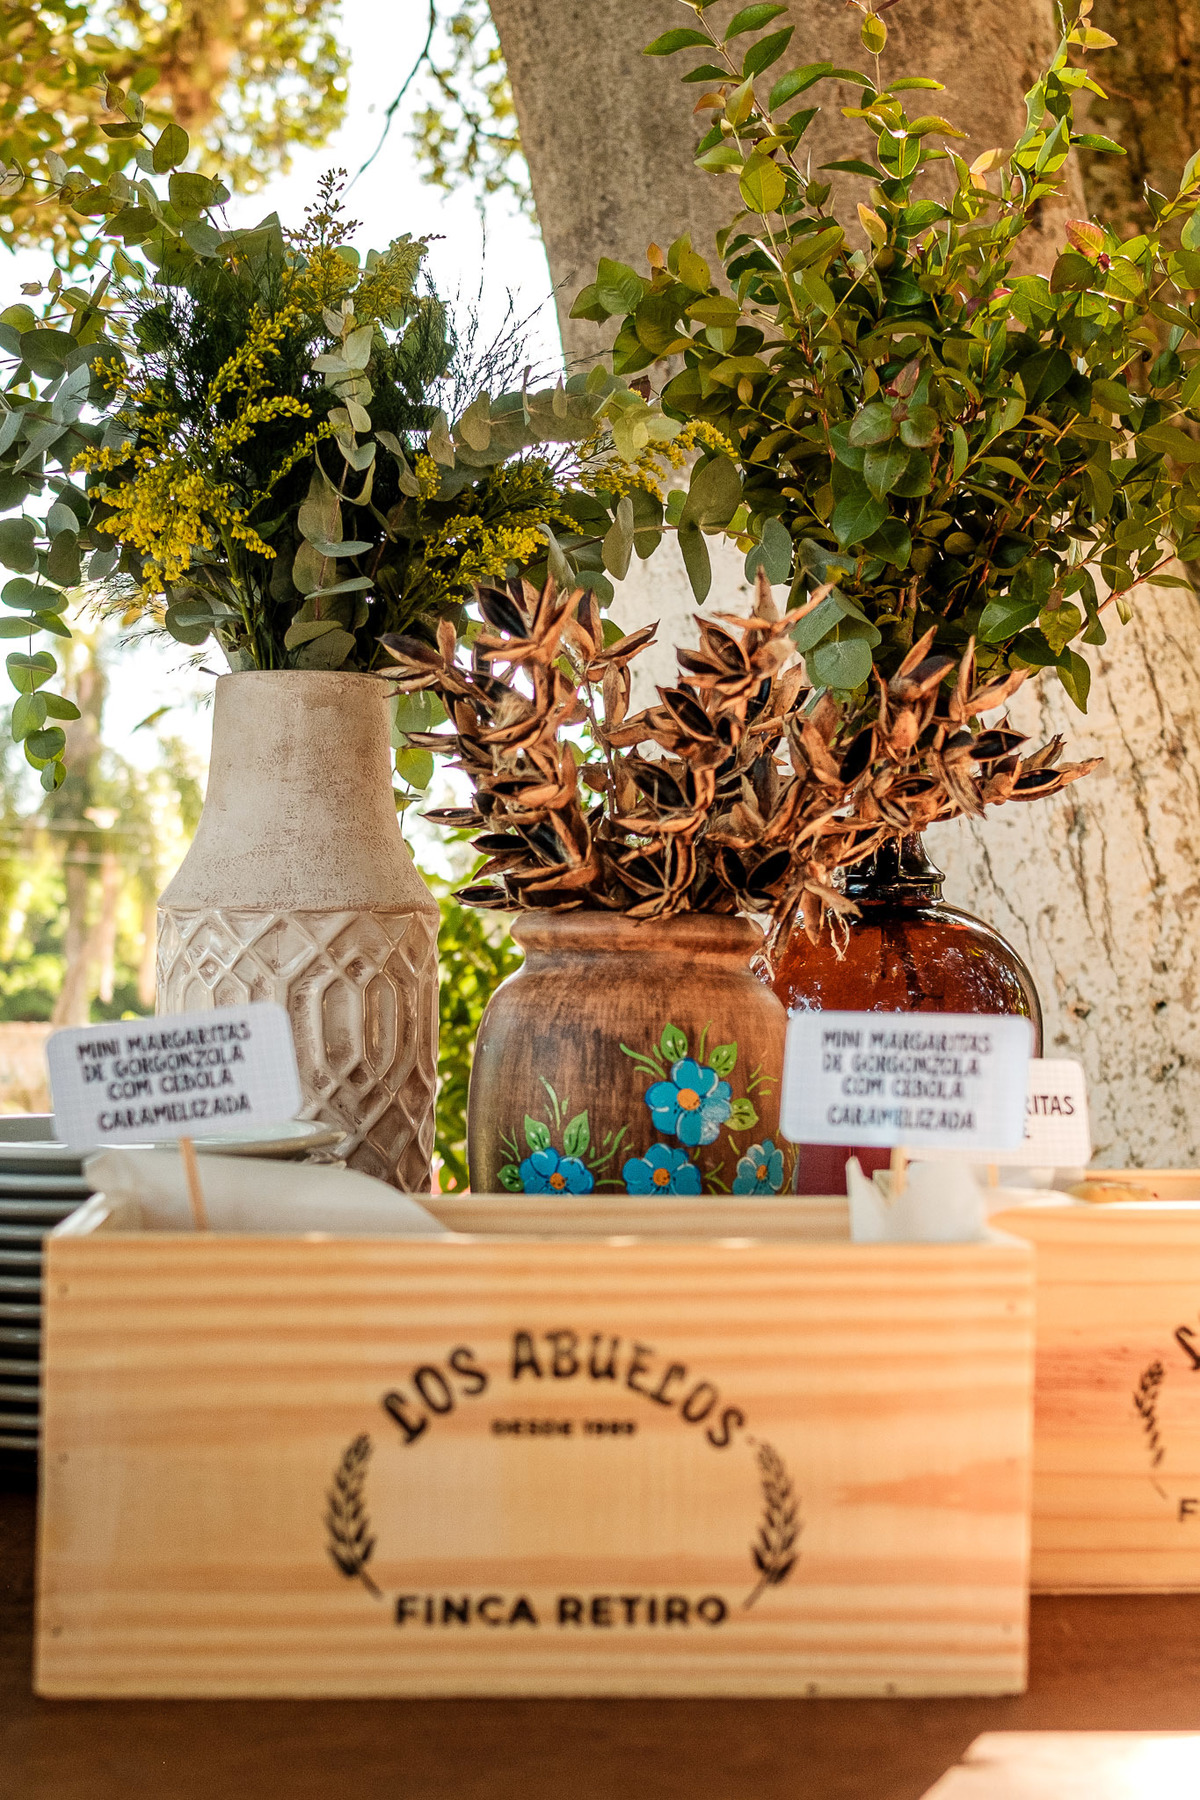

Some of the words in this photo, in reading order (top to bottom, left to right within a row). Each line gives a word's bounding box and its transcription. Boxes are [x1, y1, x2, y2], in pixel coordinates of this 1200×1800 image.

[77, 1038, 121, 1061] MINI
[127, 1021, 251, 1052] MARGARITAS
[822, 1030, 861, 1049] MINI
[871, 1031, 993, 1053] MARGARITAS
[82, 1063, 107, 1083] DE
[113, 1045, 245, 1078] GORGONZOLA
[107, 1080, 152, 1101] COM
[159, 1068, 234, 1093] CEBOLA
[841, 1077, 885, 1095] COM
[99, 1094, 251, 1131] CARAMELIZADA
[381, 1344, 489, 1445] LOS
[511, 1328, 746, 1449] ABUELOS
[394, 1595, 538, 1628] FINCA
[557, 1595, 729, 1628] RETIRO
